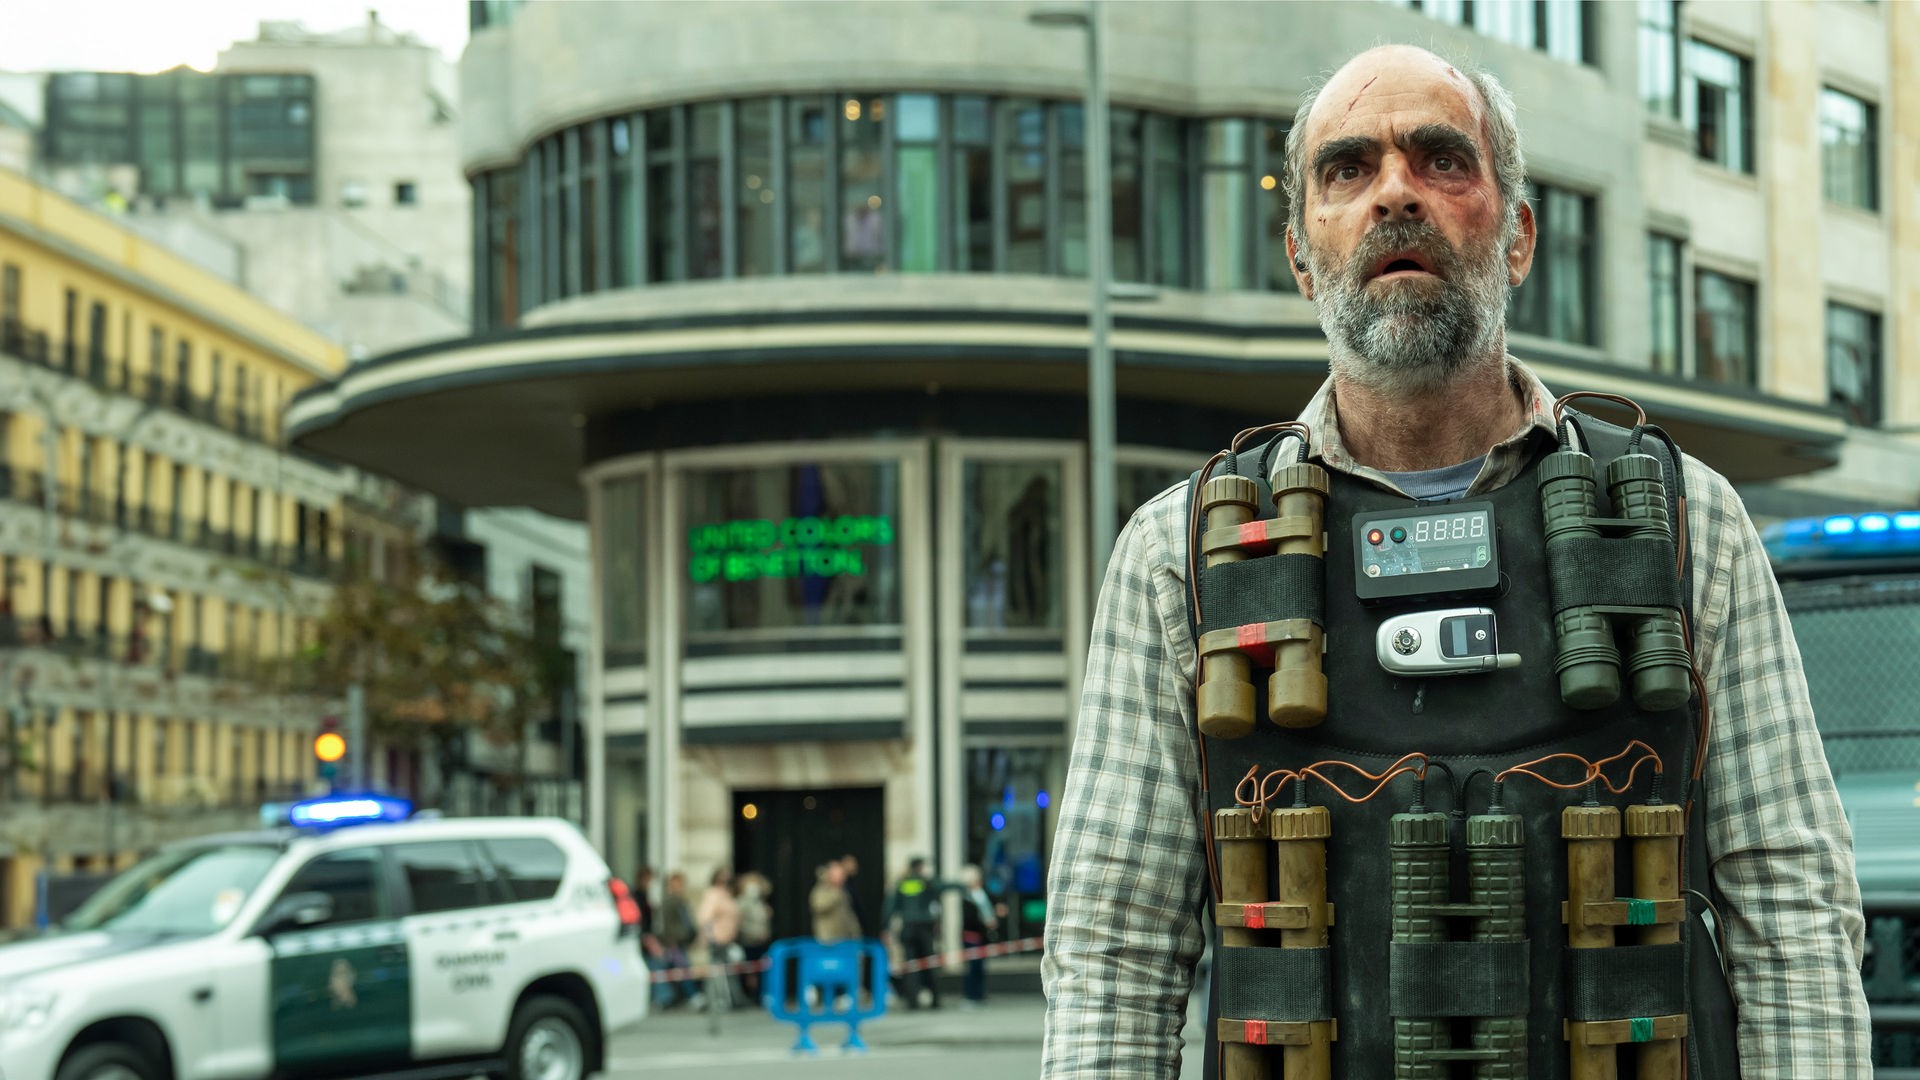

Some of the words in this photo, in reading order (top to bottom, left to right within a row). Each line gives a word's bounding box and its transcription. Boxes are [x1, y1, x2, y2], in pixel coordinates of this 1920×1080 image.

[689, 519, 776, 551] UNITED
[780, 514, 893, 546] COLORS
[689, 553, 721, 583] OF
